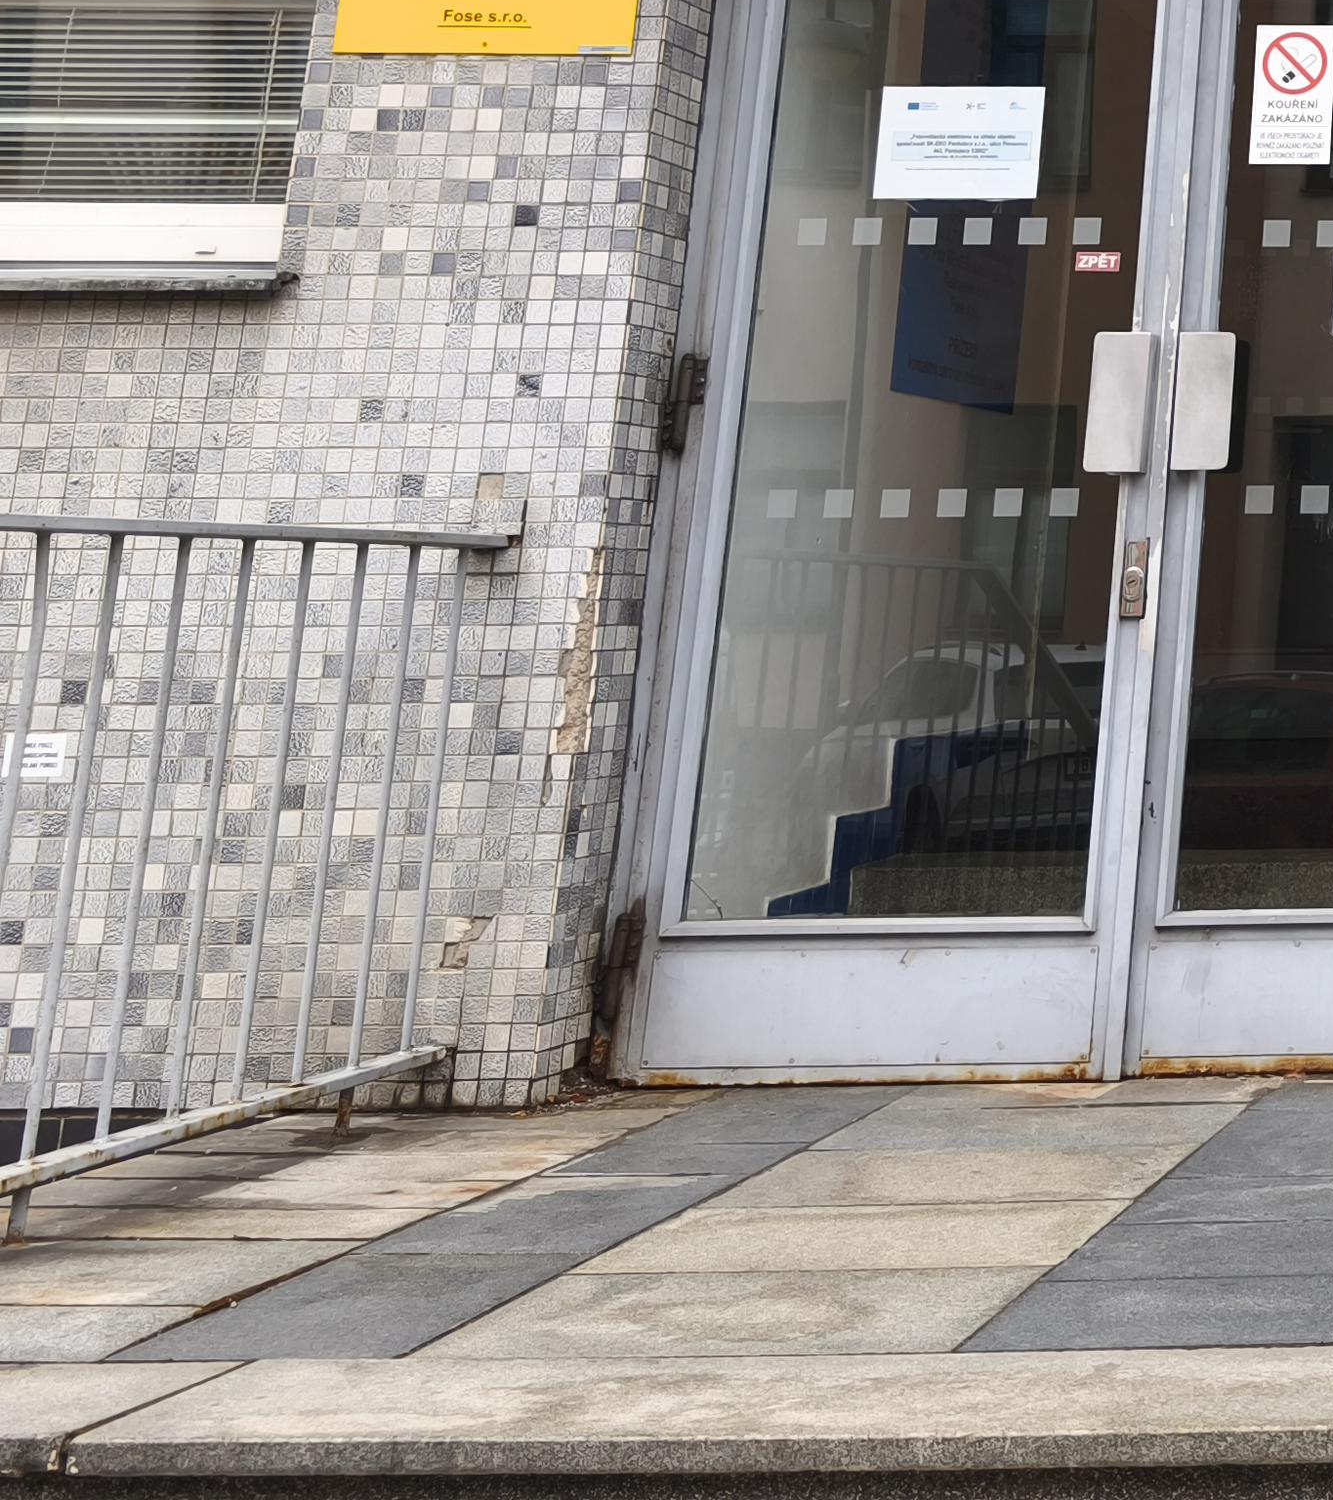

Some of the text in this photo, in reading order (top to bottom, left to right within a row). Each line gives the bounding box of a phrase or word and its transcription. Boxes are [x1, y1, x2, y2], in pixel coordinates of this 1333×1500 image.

[442, 10, 527, 23] Fose s.r.o.
[1267, 98, 1319, 109] KOUŘENÍ
[1260, 112, 1324, 124] ZAKÁZÁNO
[1077, 252, 1119, 269] ZPĚT
